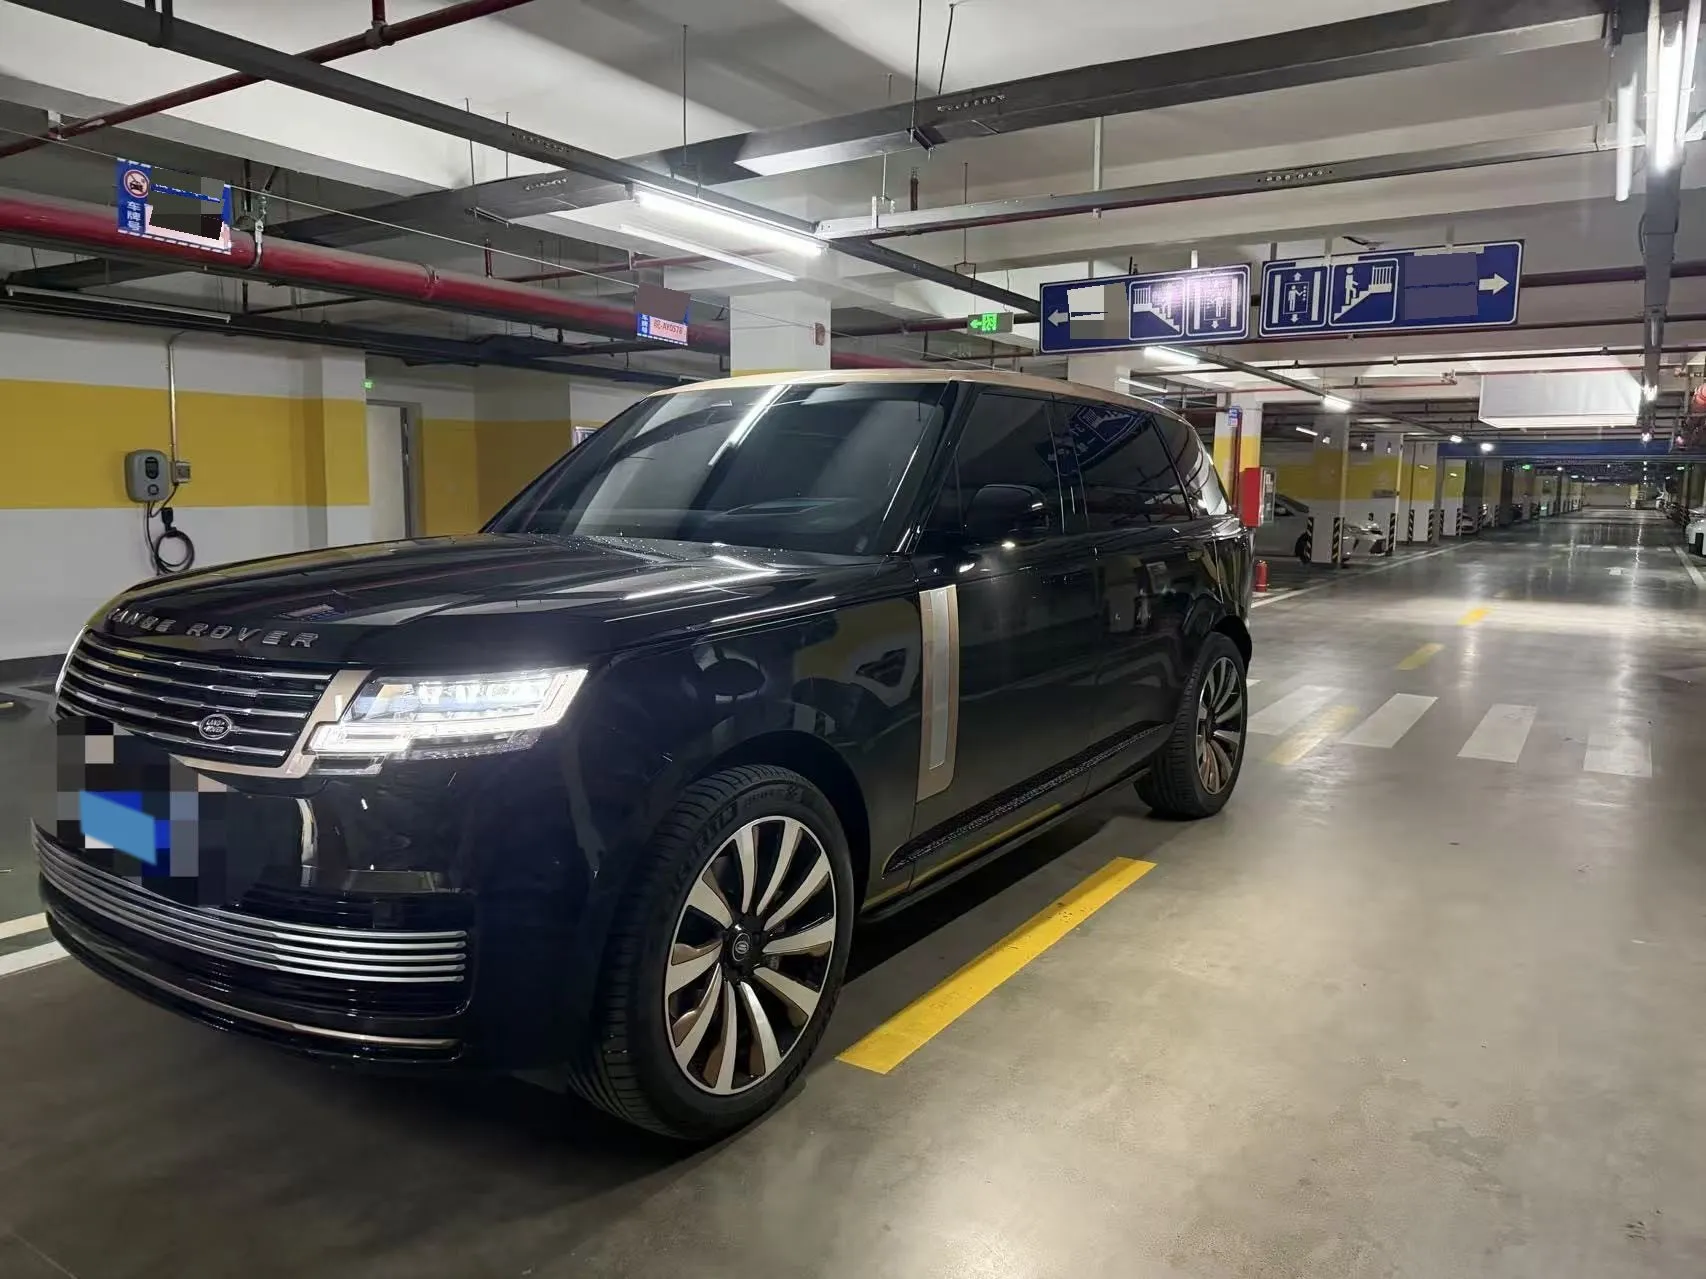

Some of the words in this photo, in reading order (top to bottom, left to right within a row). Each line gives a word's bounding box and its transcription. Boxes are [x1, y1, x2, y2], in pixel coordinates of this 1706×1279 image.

[126, 200, 142, 231] 车牌号
[185, 622, 319, 648] ROVER
